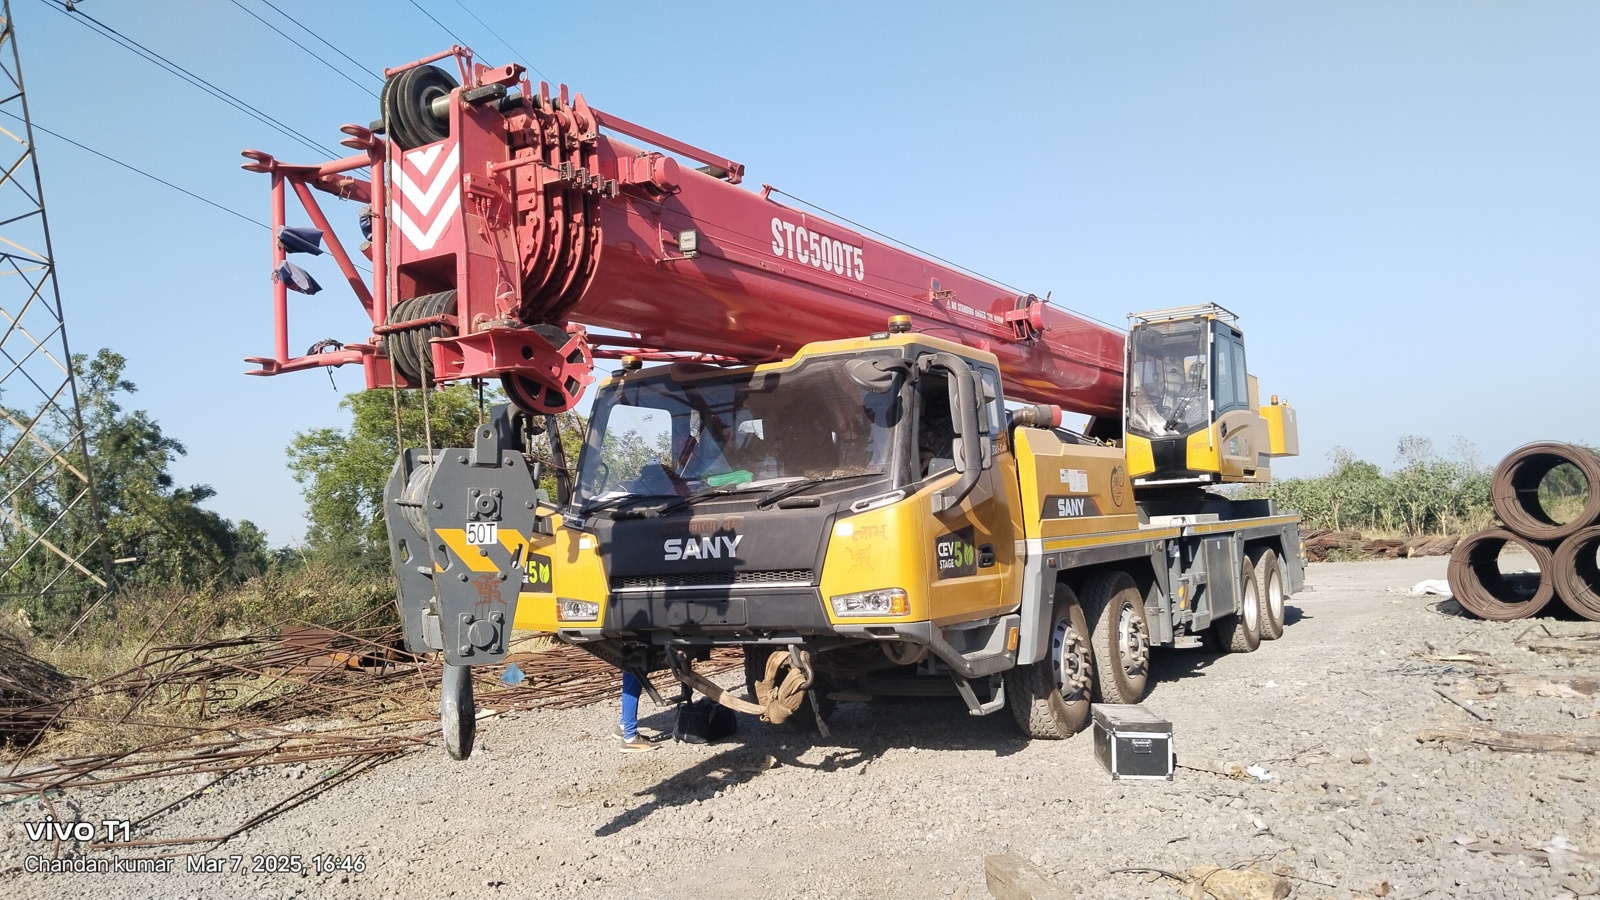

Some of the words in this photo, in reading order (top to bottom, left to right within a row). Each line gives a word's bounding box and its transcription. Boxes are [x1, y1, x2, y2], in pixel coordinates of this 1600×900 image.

[771, 217, 865, 281] STC500T5
[1057, 498, 1084, 517] SANY
[467, 523, 496, 544] 50T
[663, 534, 744, 561] SANY
[937, 541, 955, 557] CEV
[954, 541, 963, 568] 5
[528, 560, 538, 584] 5
[939, 558, 955, 570] STAGE
